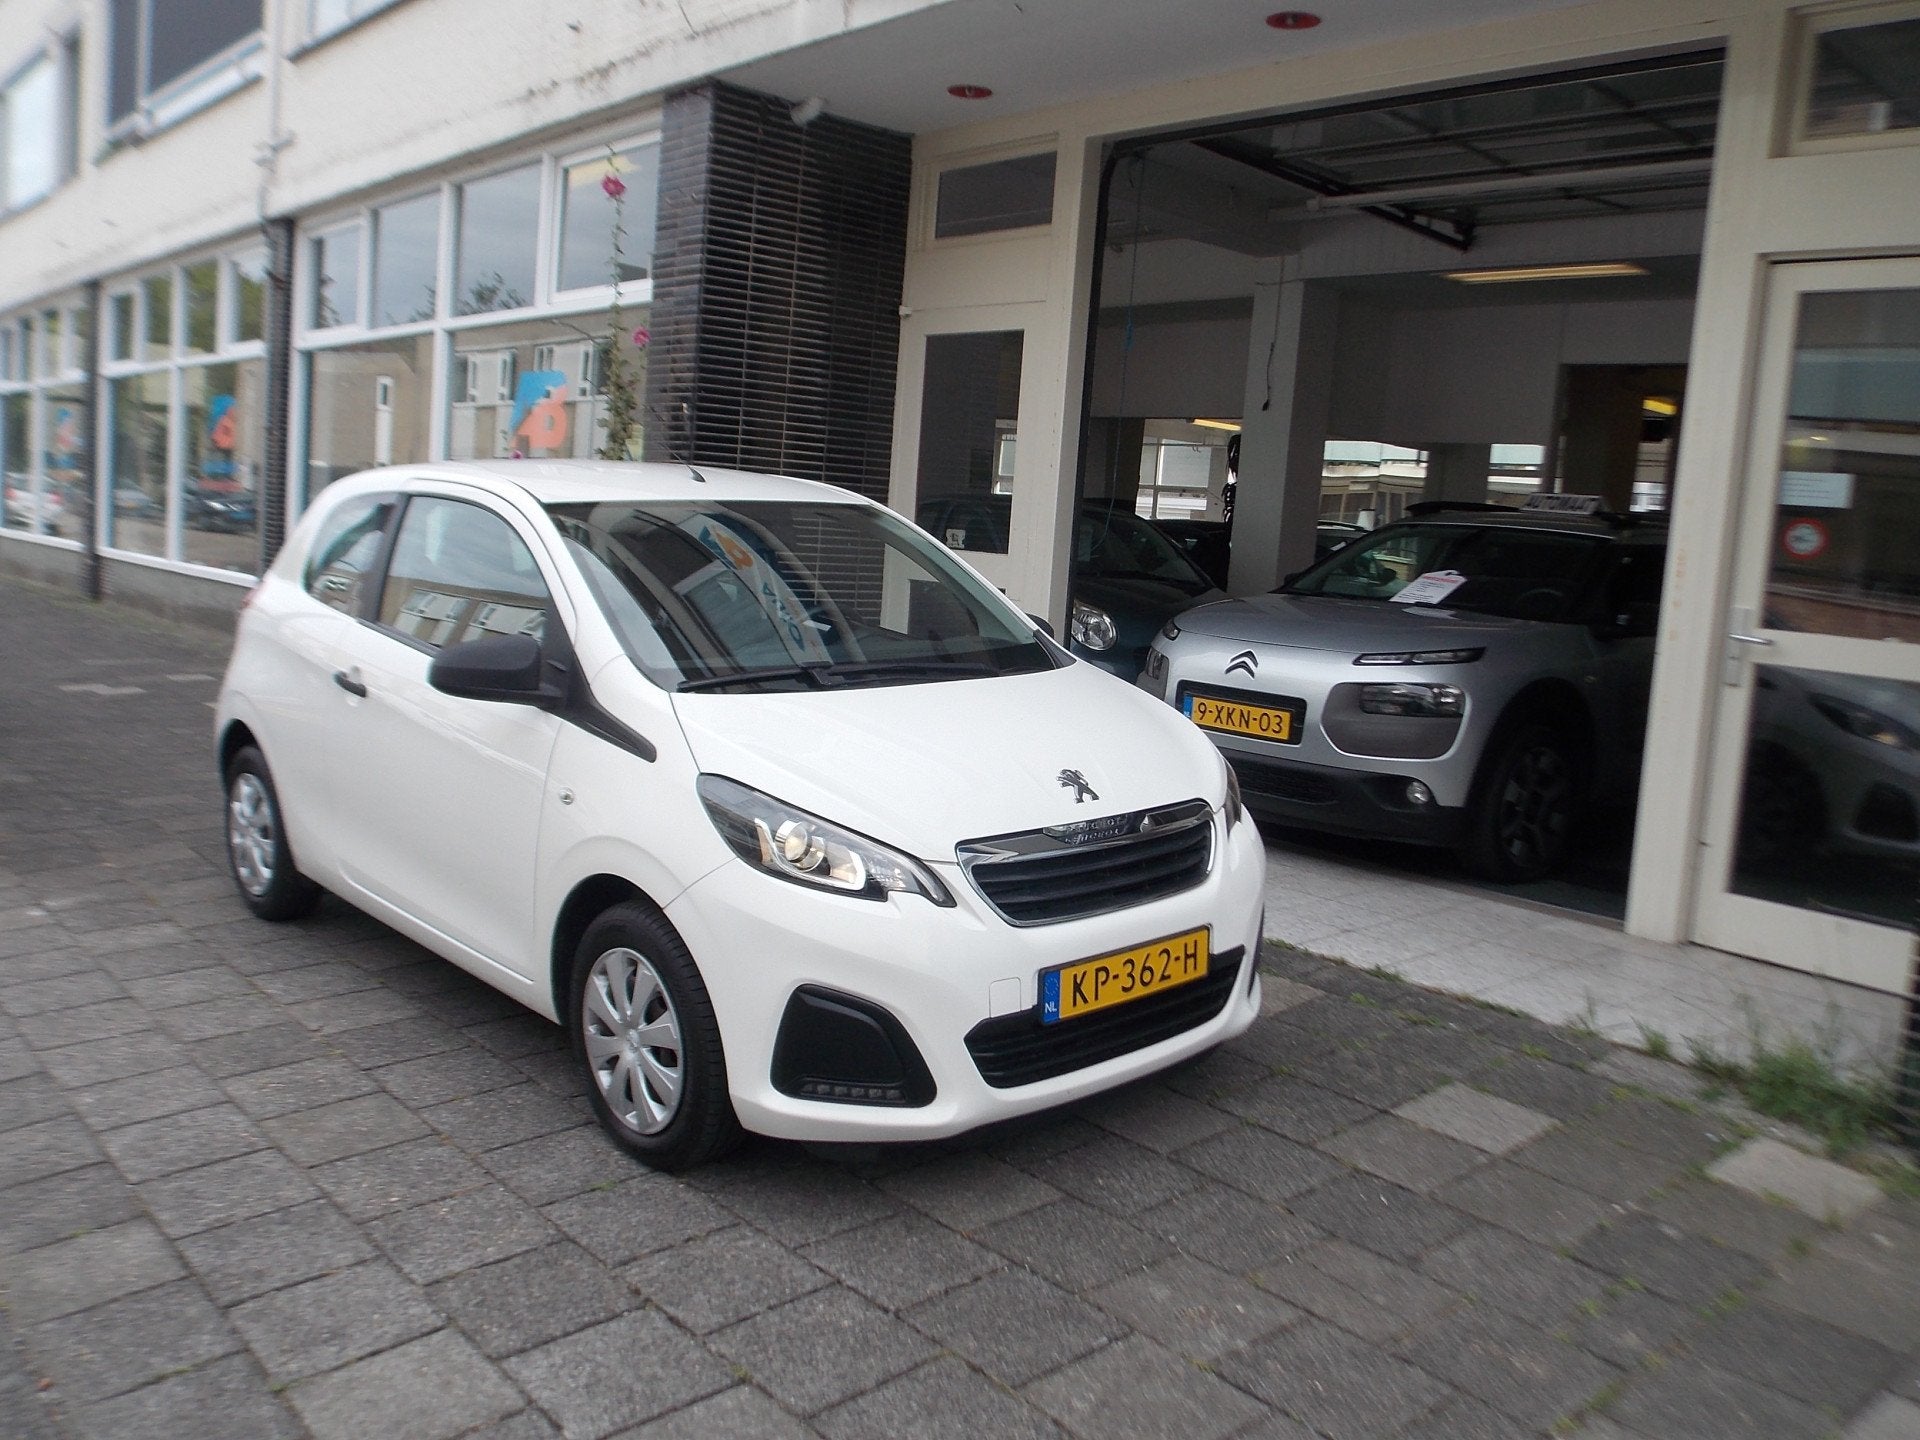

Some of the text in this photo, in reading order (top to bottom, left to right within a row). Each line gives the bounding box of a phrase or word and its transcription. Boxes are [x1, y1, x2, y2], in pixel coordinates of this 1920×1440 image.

[1197, 702, 1283, 734] 9-XKN-03
[1072, 939, 1198, 1008] KP-362-H
[1044, 1002, 1058, 1013] NL
